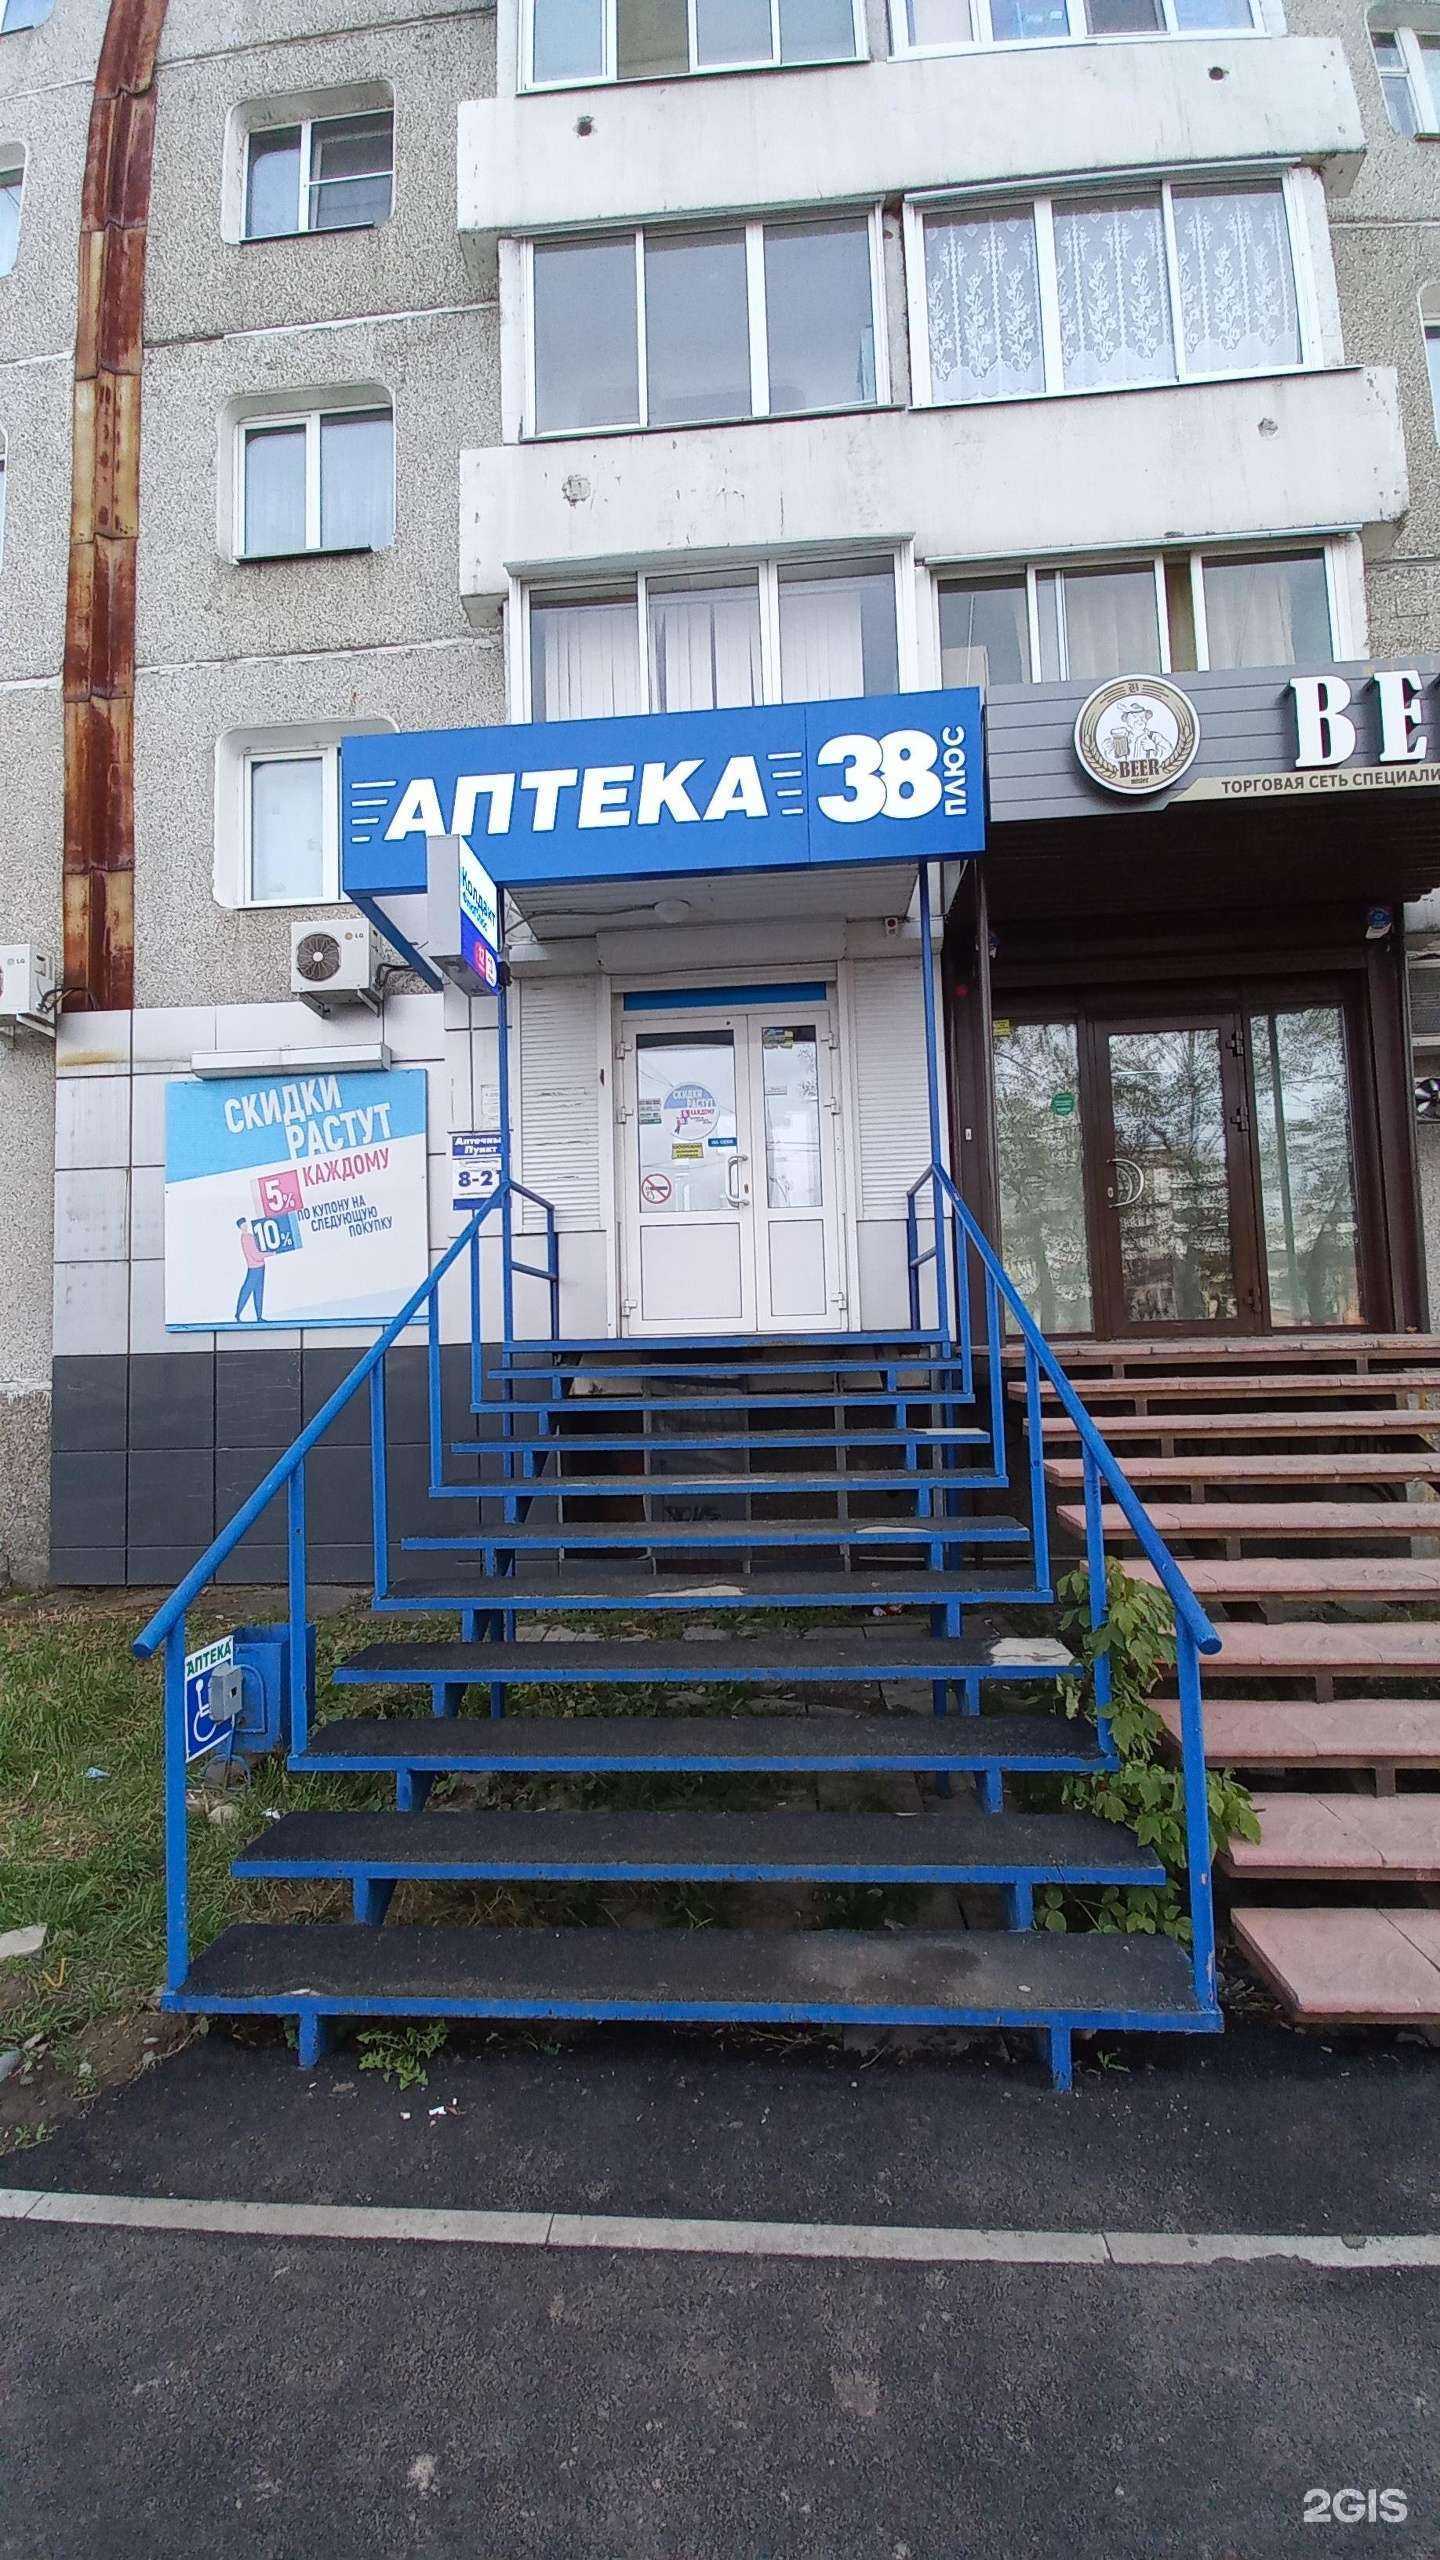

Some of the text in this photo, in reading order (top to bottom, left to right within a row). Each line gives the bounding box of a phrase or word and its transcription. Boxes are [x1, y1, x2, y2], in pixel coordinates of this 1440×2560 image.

[384, 728, 943, 841] АПТЕКА 38
[943, 725, 966, 816] ПЛЮС
[1119, 759, 1160, 778] BEER
[1221, 776, 1305, 794] ТОРГОВАЯ
[1309, 774, 1349, 789] СЕТЬ
[224, 1075, 343, 1134] СКИДКИ
[285, 1102, 391, 1160] РАСТУТ
[454, 1137, 502, 1146] Аптечны
[303, 1148, 389, 1187] КАЖДОМУ
[464, 1146, 498, 1156] Пункт
[264, 1179, 295, 1212] 5%
[297, 1195, 366, 1221] ПО КУПОНУ НА
[311, 1206, 378, 1231] СЛЕДУЮЩУЮ
[349, 1216, 393, 1237] ПОКУПКУ
[253, 1219, 293, 1252] 10%
[187, 1640, 231, 1676] АПТЕКА
